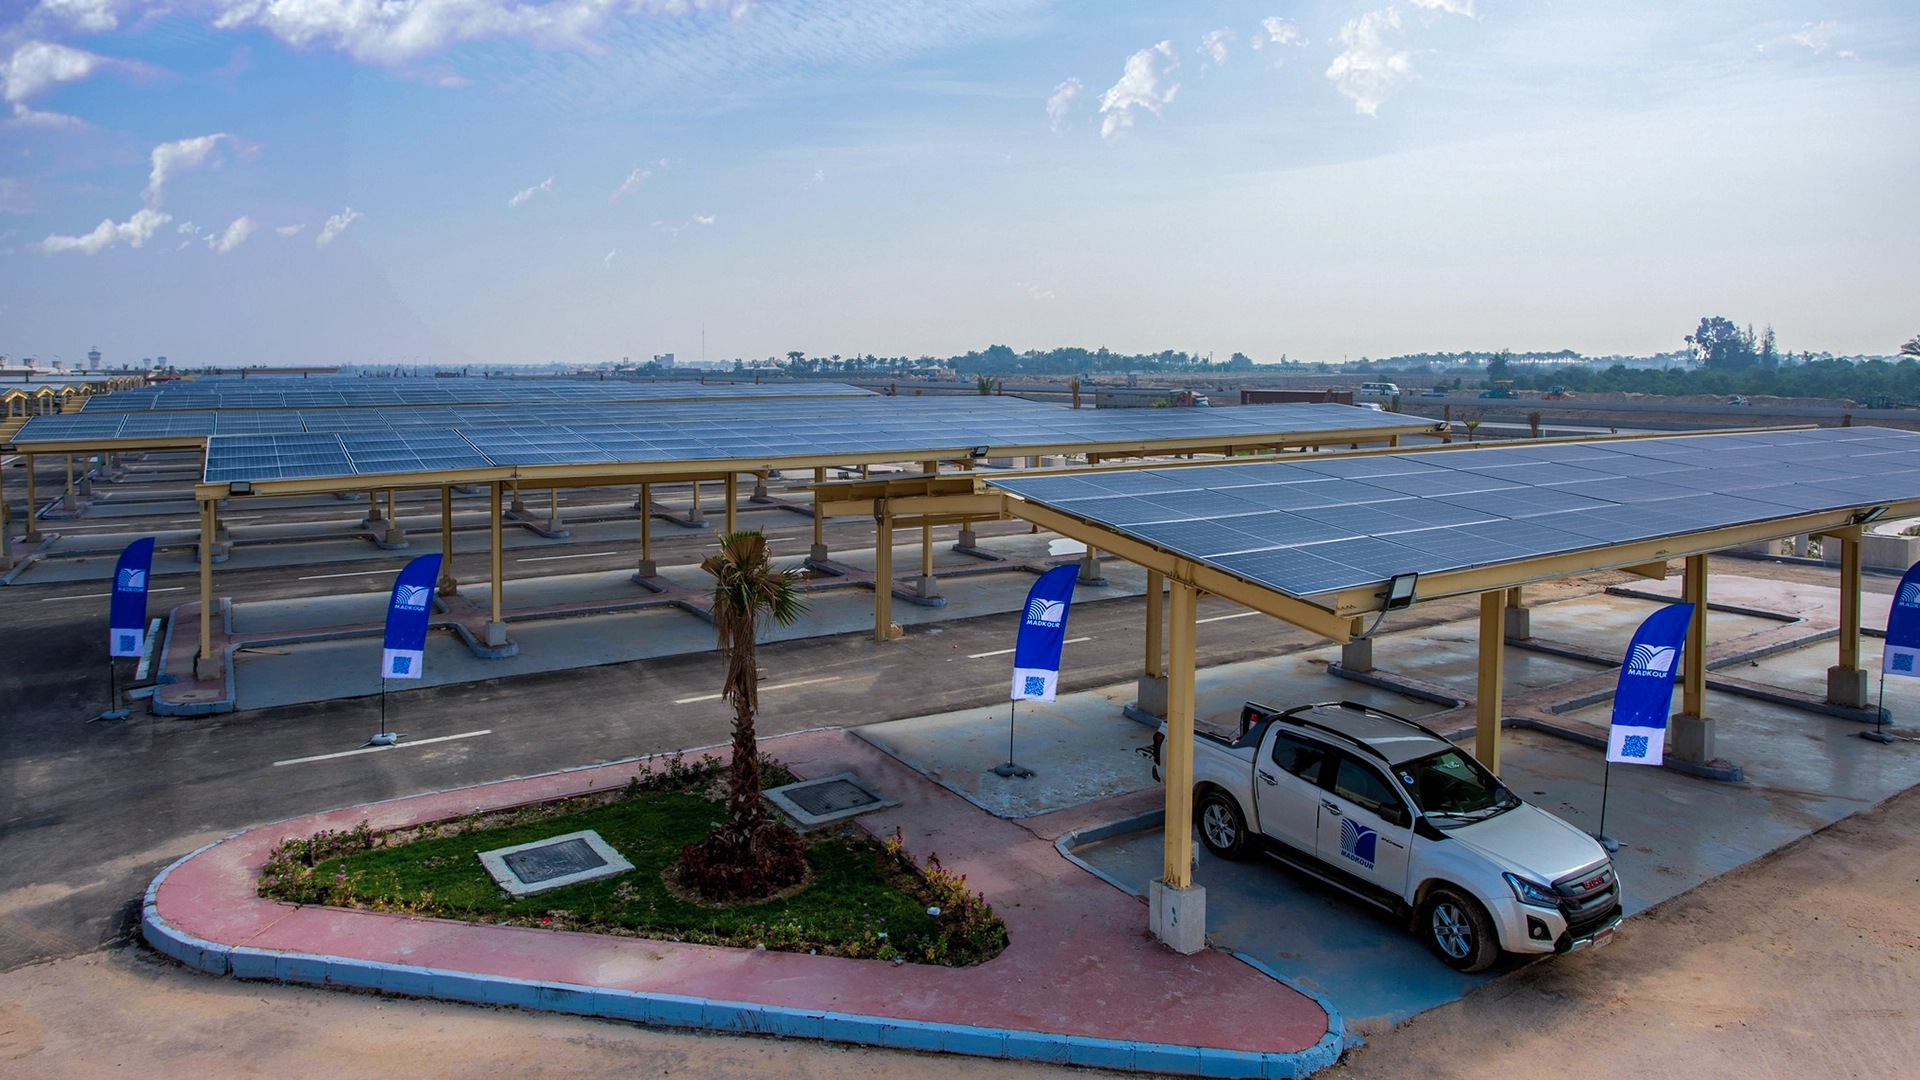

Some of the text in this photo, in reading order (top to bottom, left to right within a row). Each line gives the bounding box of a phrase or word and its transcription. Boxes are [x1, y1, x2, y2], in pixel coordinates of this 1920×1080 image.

[1026, 619, 1060, 628] MADKOUR
[1628, 669, 1668, 678] MADKOUR
[1340, 849, 1375, 871] MADKOUR
